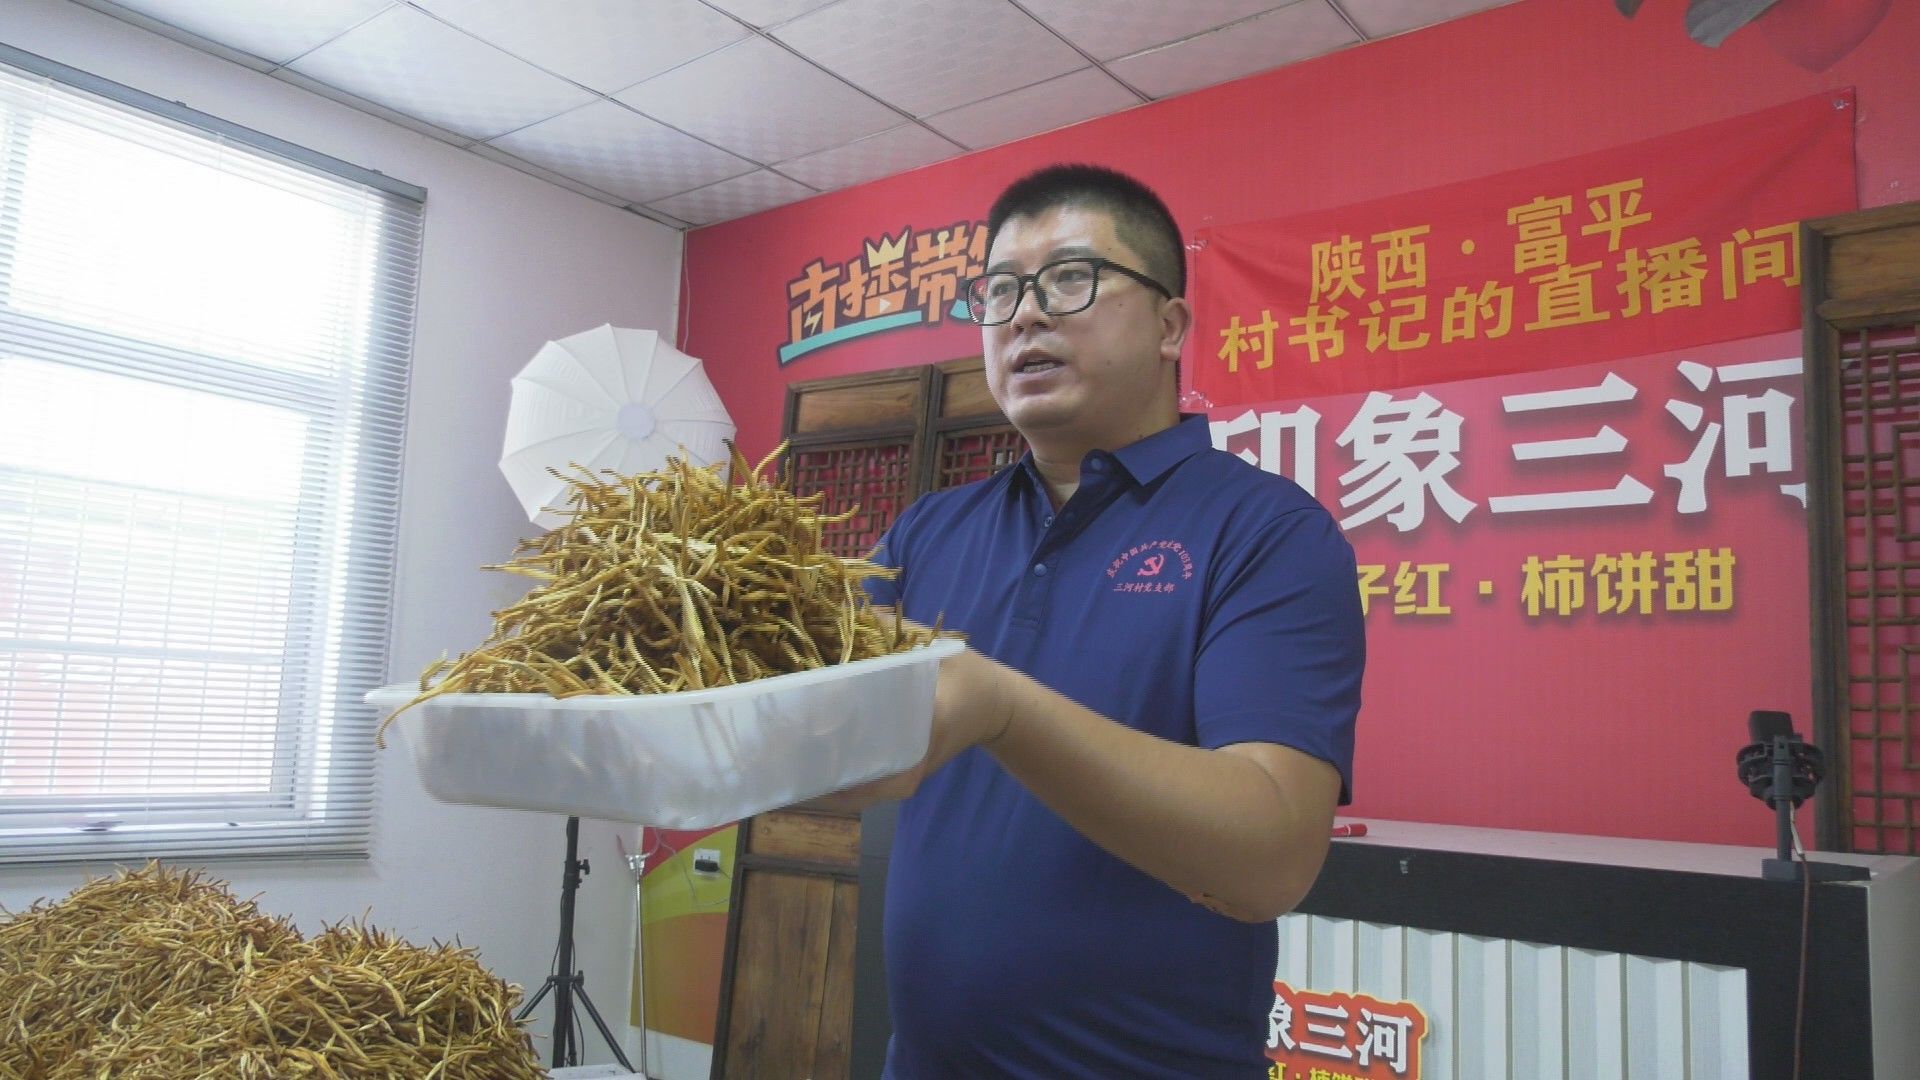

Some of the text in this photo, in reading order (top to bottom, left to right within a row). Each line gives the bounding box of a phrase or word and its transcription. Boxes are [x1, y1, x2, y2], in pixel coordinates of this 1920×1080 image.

[1218, 221, 1800, 372] 村书记的直播间
[1310, 178, 1652, 303] 陕西·富平
[1208, 357, 1806, 532] 印象三河
[1113, 582, 1176, 594] 三河村党支部
